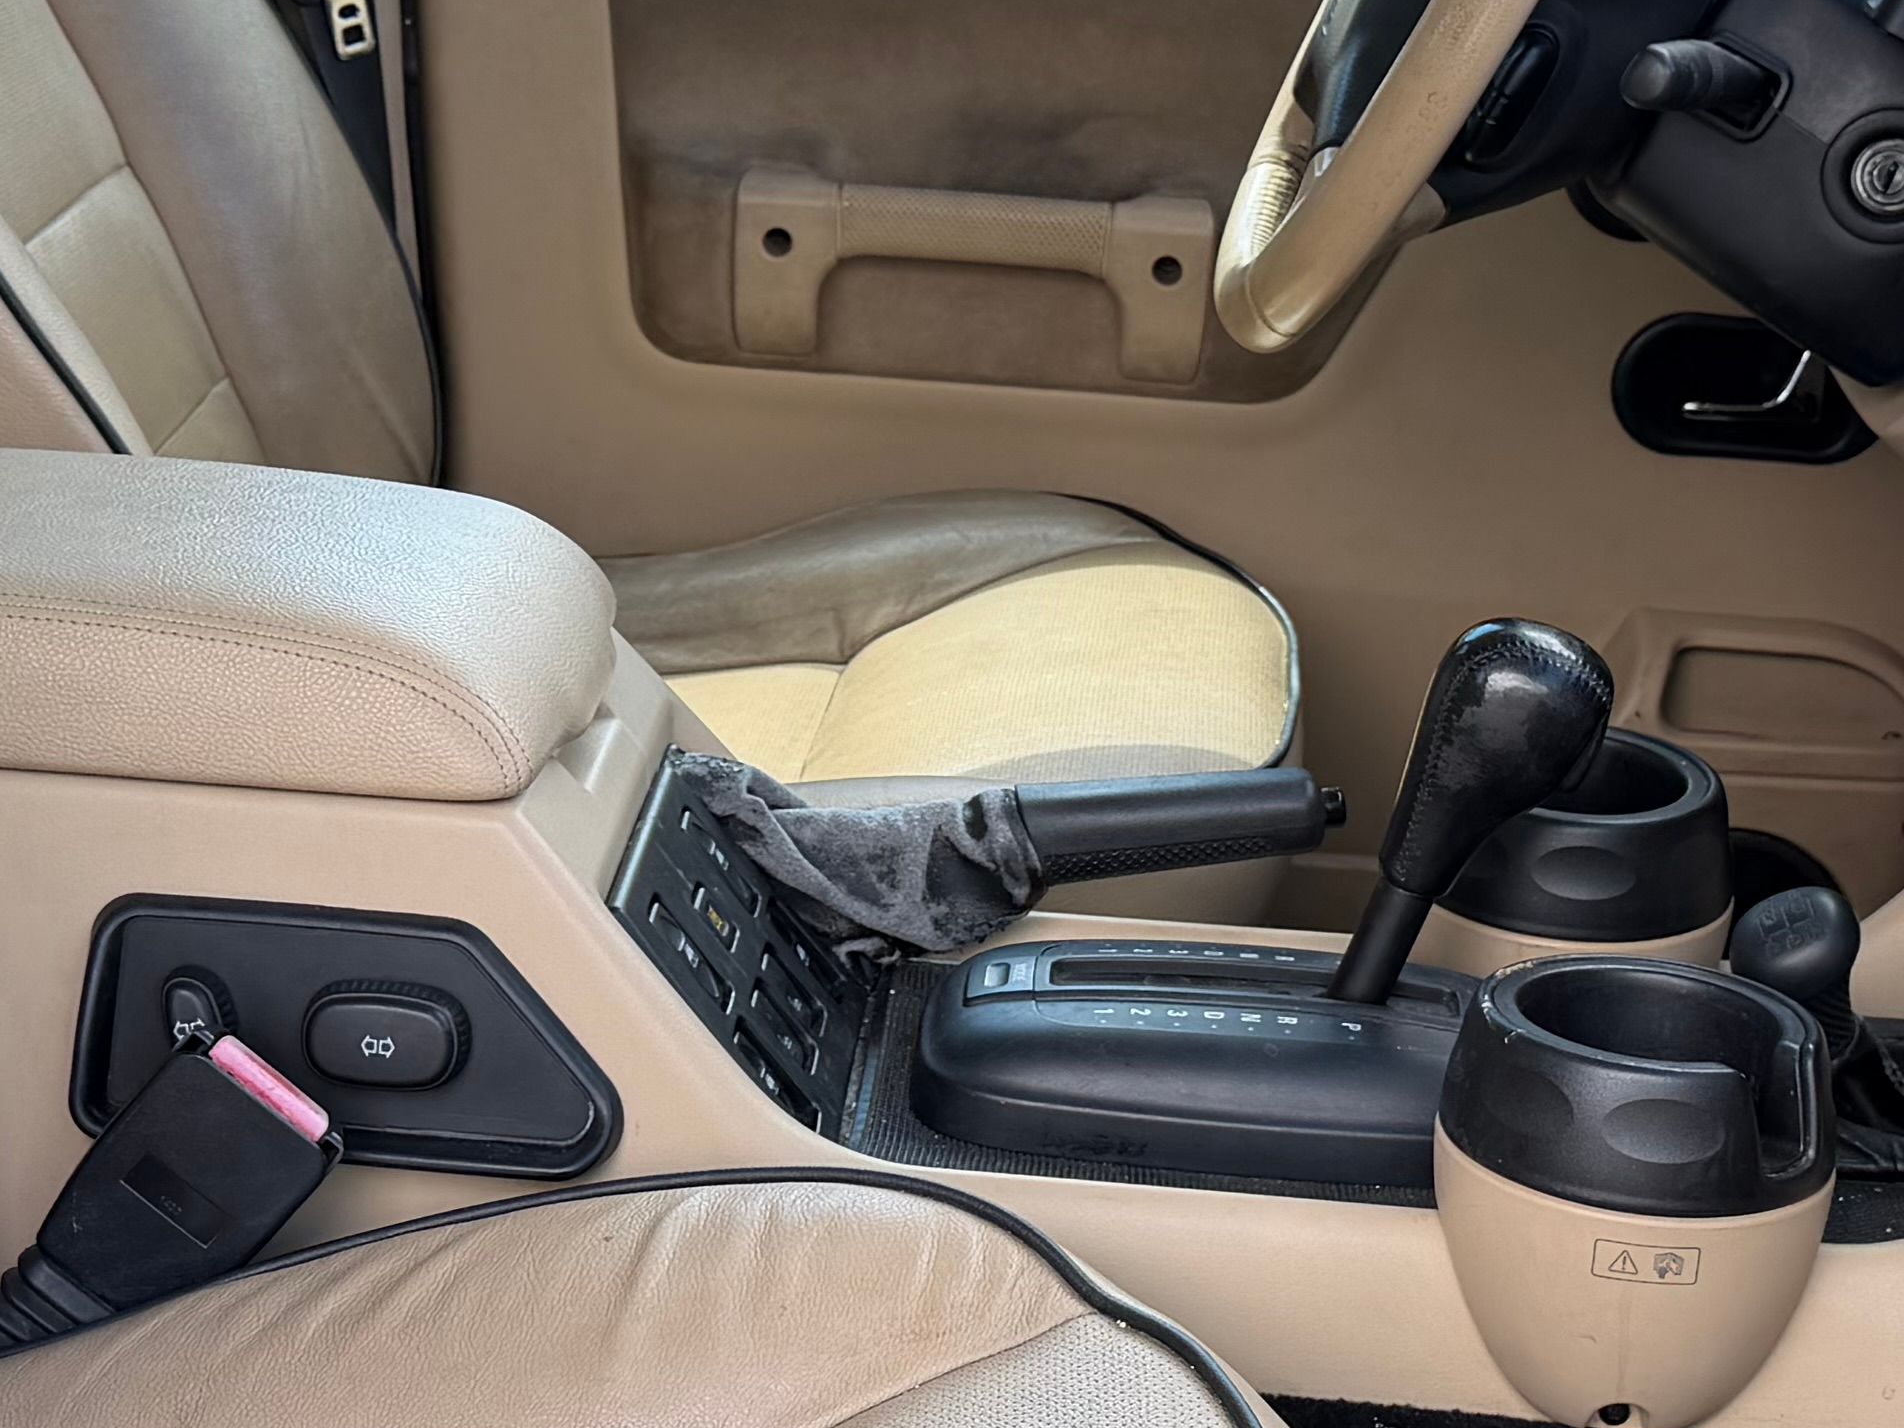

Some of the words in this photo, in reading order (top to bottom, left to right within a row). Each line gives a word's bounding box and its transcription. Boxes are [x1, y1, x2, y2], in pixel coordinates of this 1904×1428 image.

[1129, 1008, 1152, 1016] 2
[1166, 1009, 1188, 1017] 3
[1203, 1011, 1225, 1019] D
[1277, 1016, 1299, 1025] R
[1341, 1022, 1362, 1031] P
